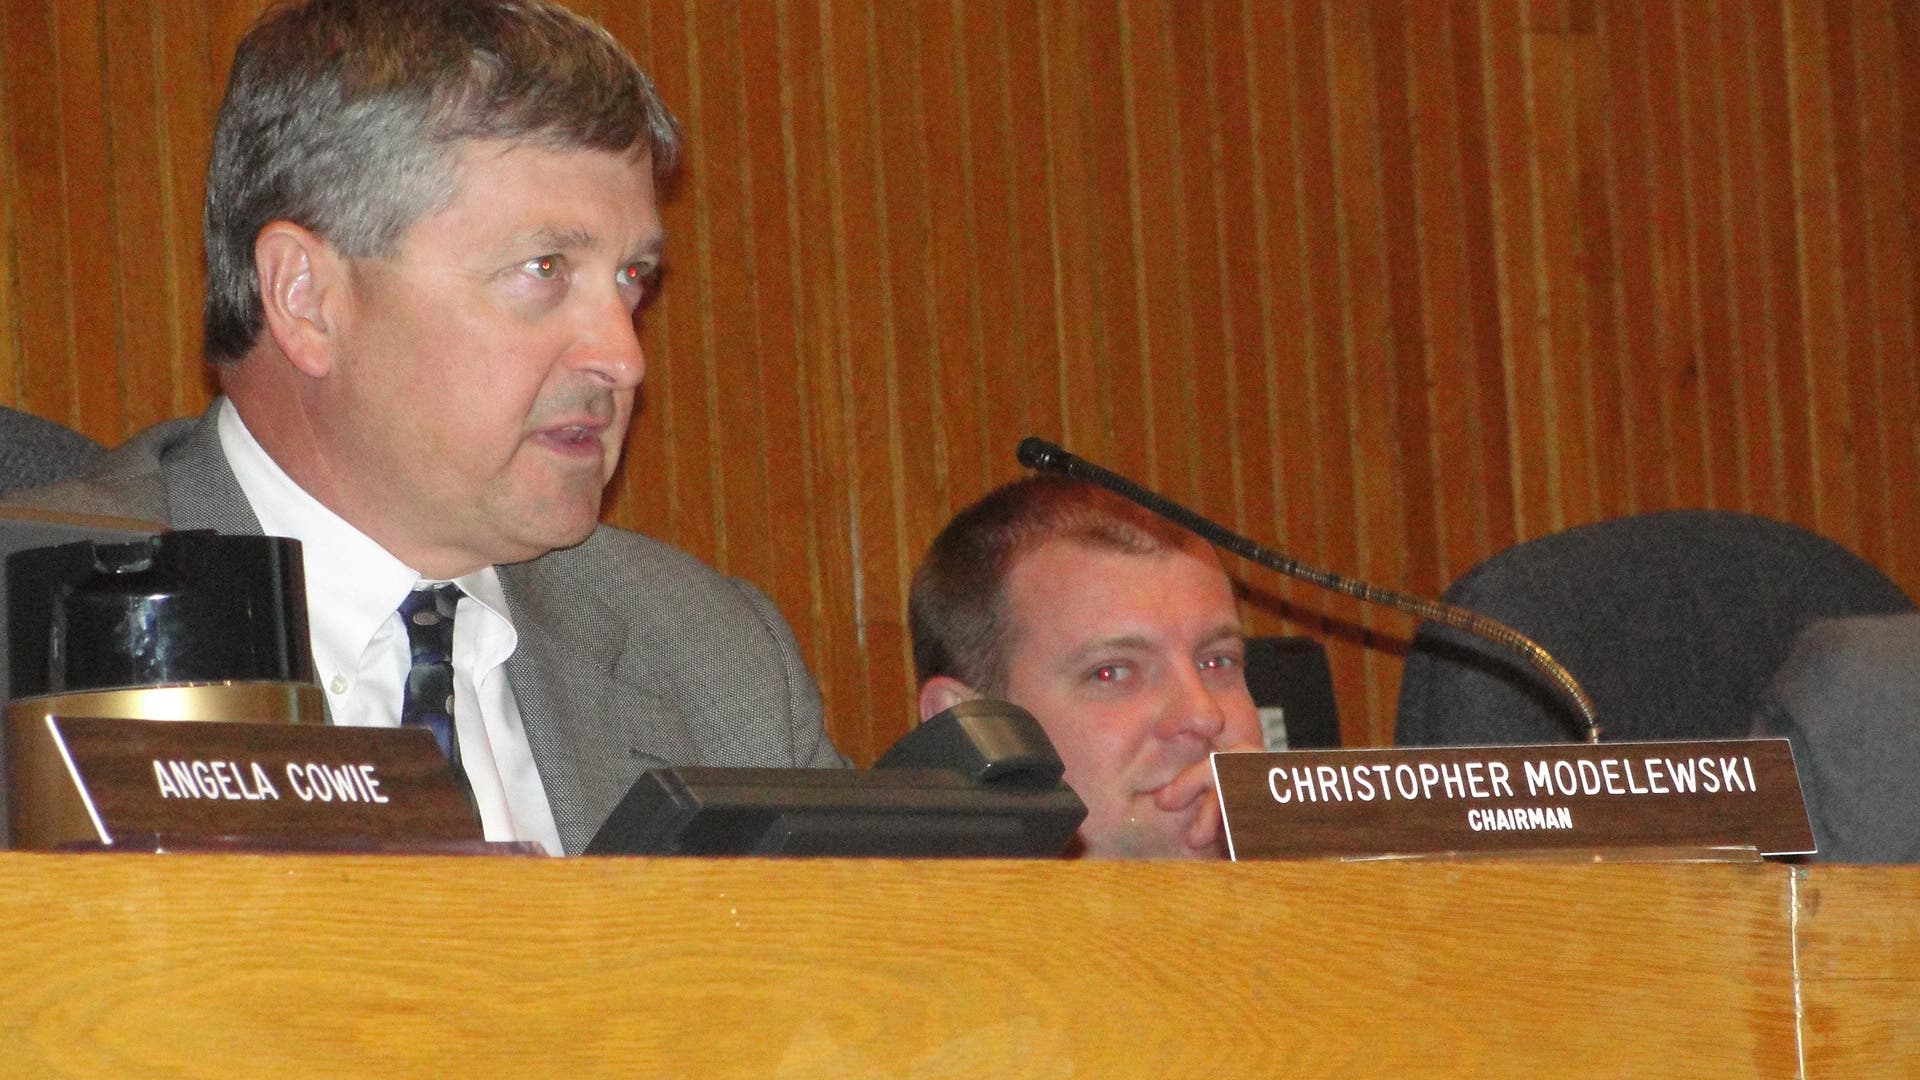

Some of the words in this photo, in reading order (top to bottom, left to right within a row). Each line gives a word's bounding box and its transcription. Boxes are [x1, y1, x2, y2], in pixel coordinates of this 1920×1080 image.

[152, 759, 280, 801] ANGELA
[285, 762, 390, 804] COWIE
[1268, 761, 1514, 804] CHRISTOPHER
[1523, 756, 1757, 797] MODELEWSKI
[1467, 807, 1574, 832] CHAIRMAN
